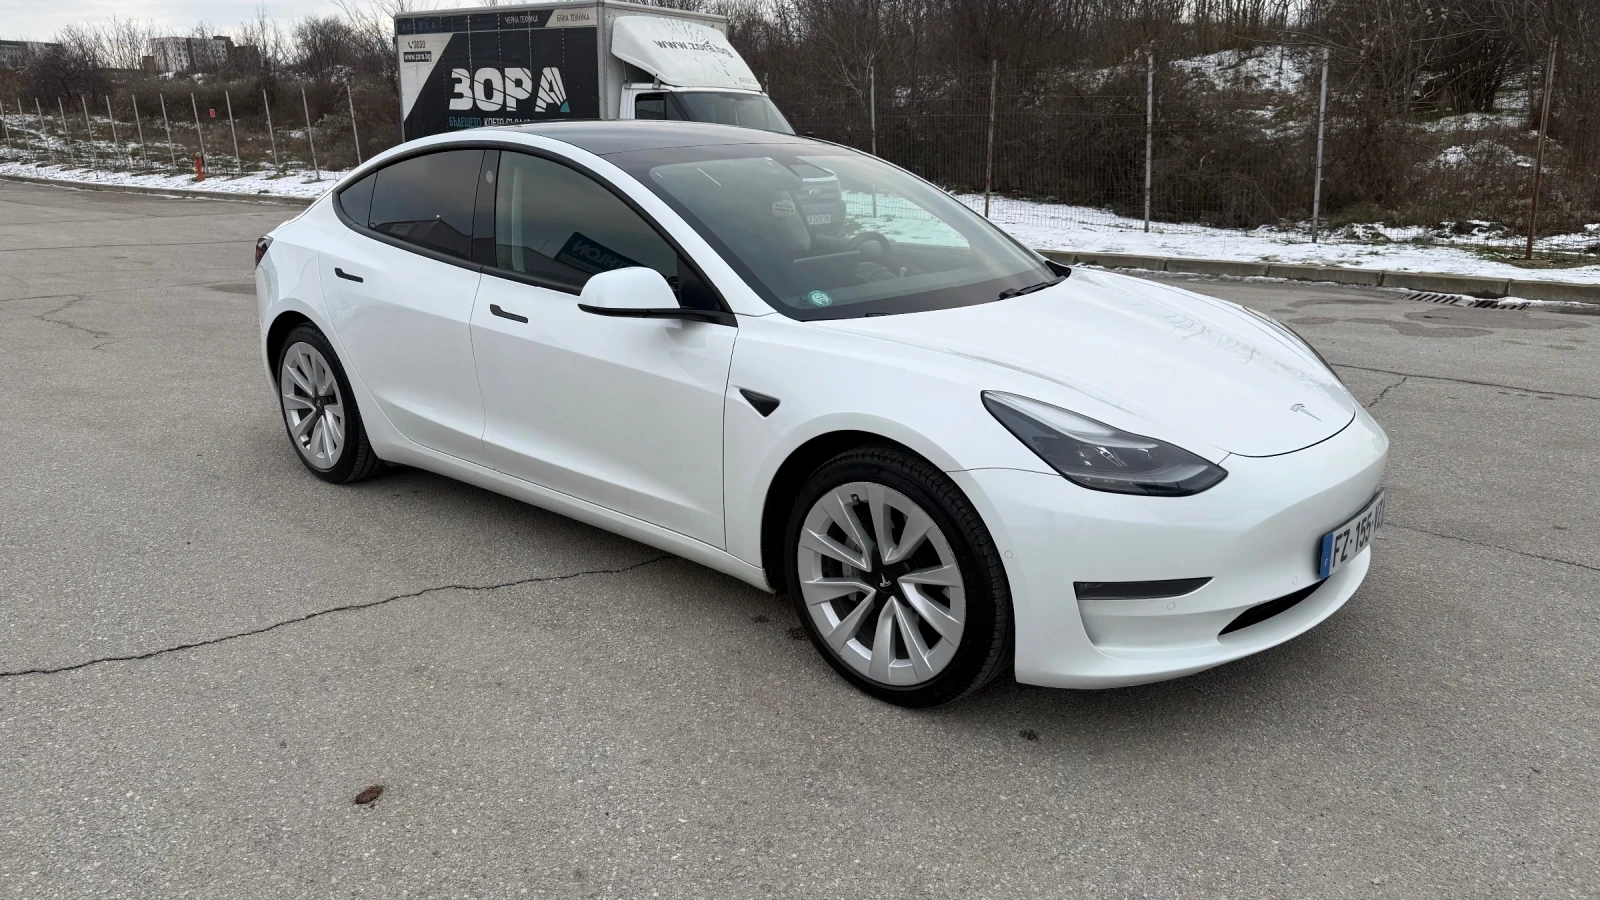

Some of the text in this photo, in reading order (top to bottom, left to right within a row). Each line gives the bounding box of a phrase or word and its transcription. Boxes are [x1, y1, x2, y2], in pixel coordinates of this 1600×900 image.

[504, 15, 519, 24] ЧЕРНА
[653, 39, 734, 59] www.zora.bg
[449, 67, 570, 112] ЗОРА
